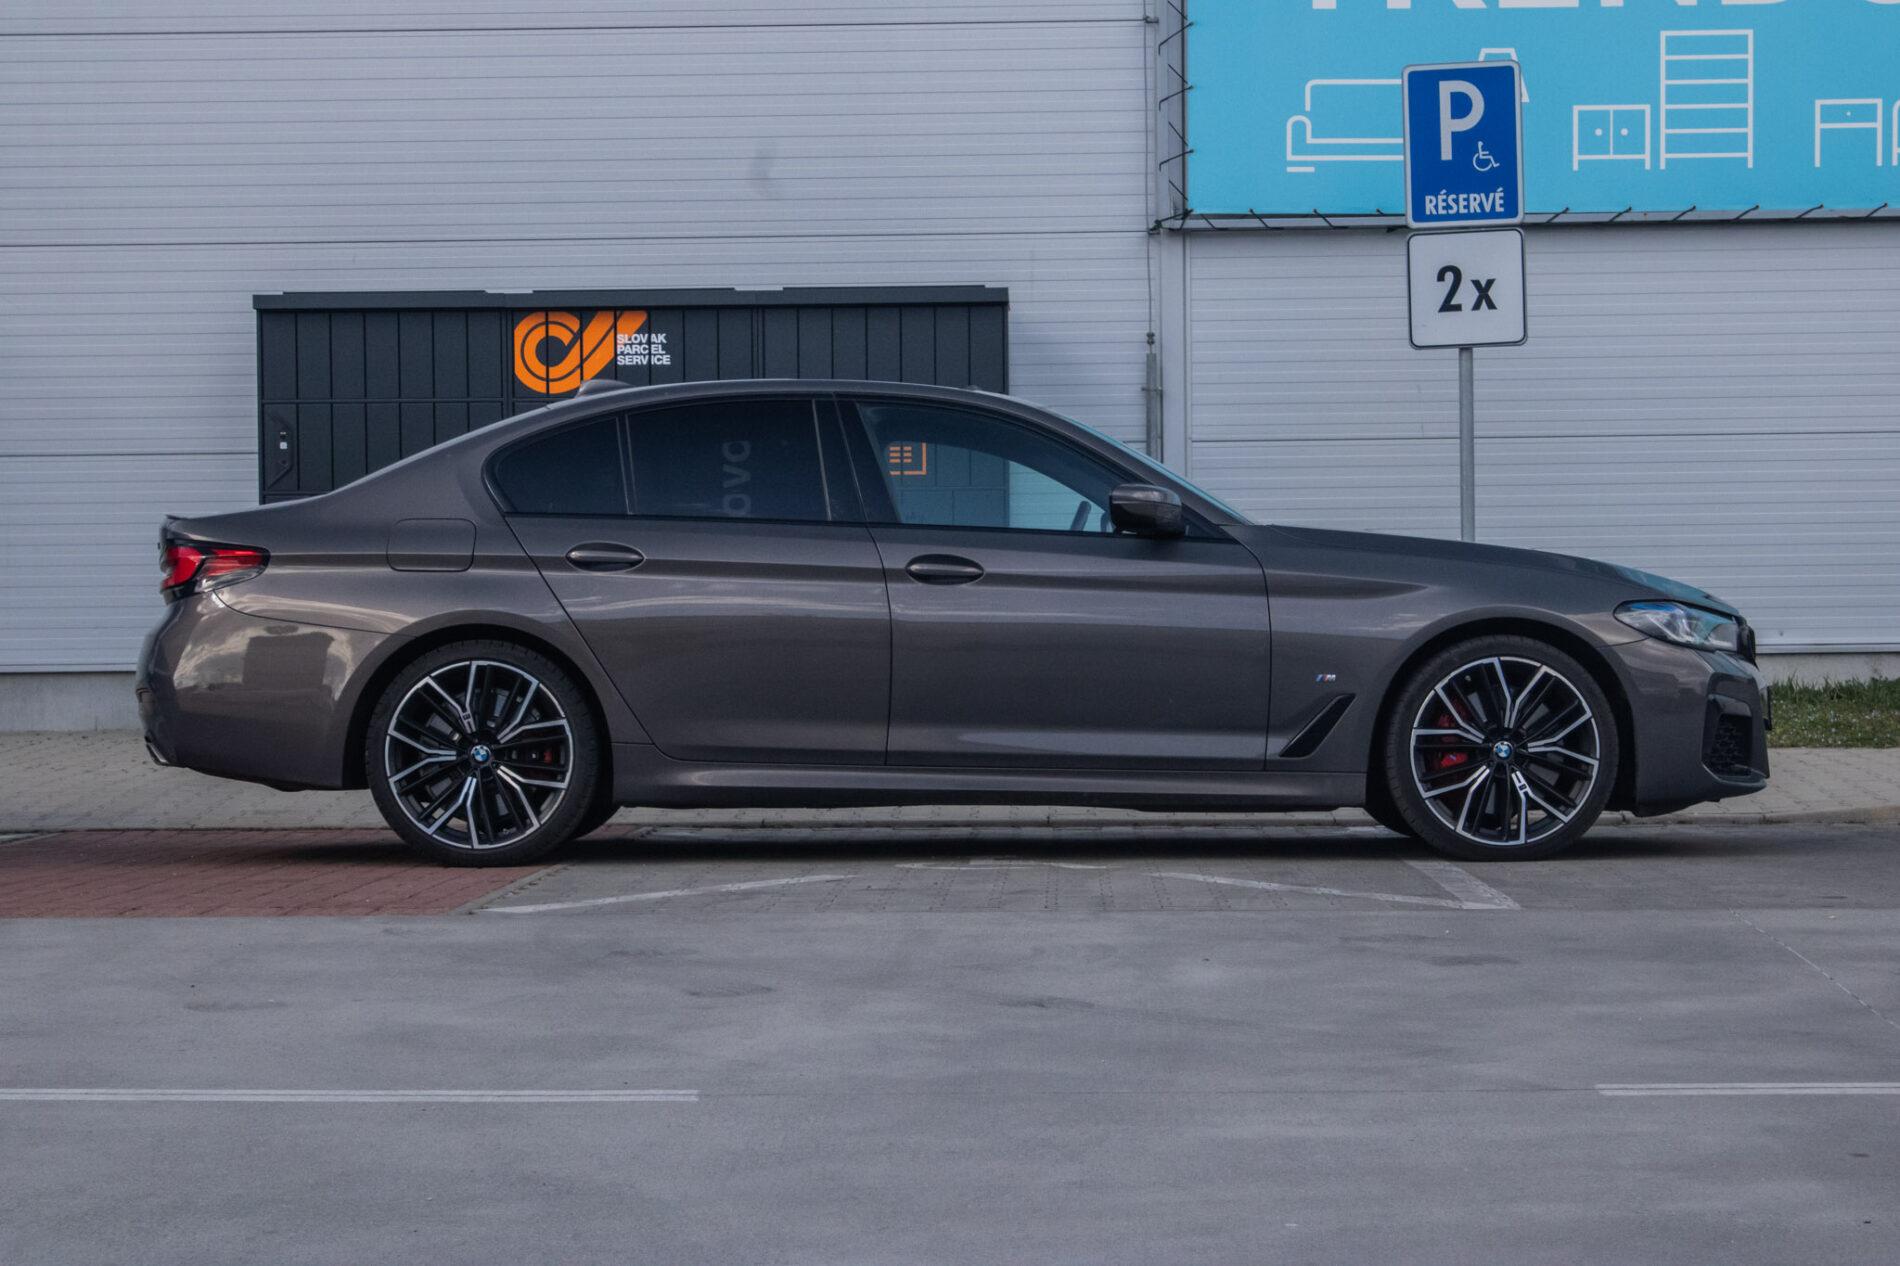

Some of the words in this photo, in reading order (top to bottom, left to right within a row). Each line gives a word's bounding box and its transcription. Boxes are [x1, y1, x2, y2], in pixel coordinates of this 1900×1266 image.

[1439, 80, 1485, 161] P
[1425, 187, 1505, 216] RÉSERVÉ
[616, 333, 667, 344] SLOVAK
[616, 344, 666, 355] PARCEL
[616, 355, 671, 366] SERVICE
